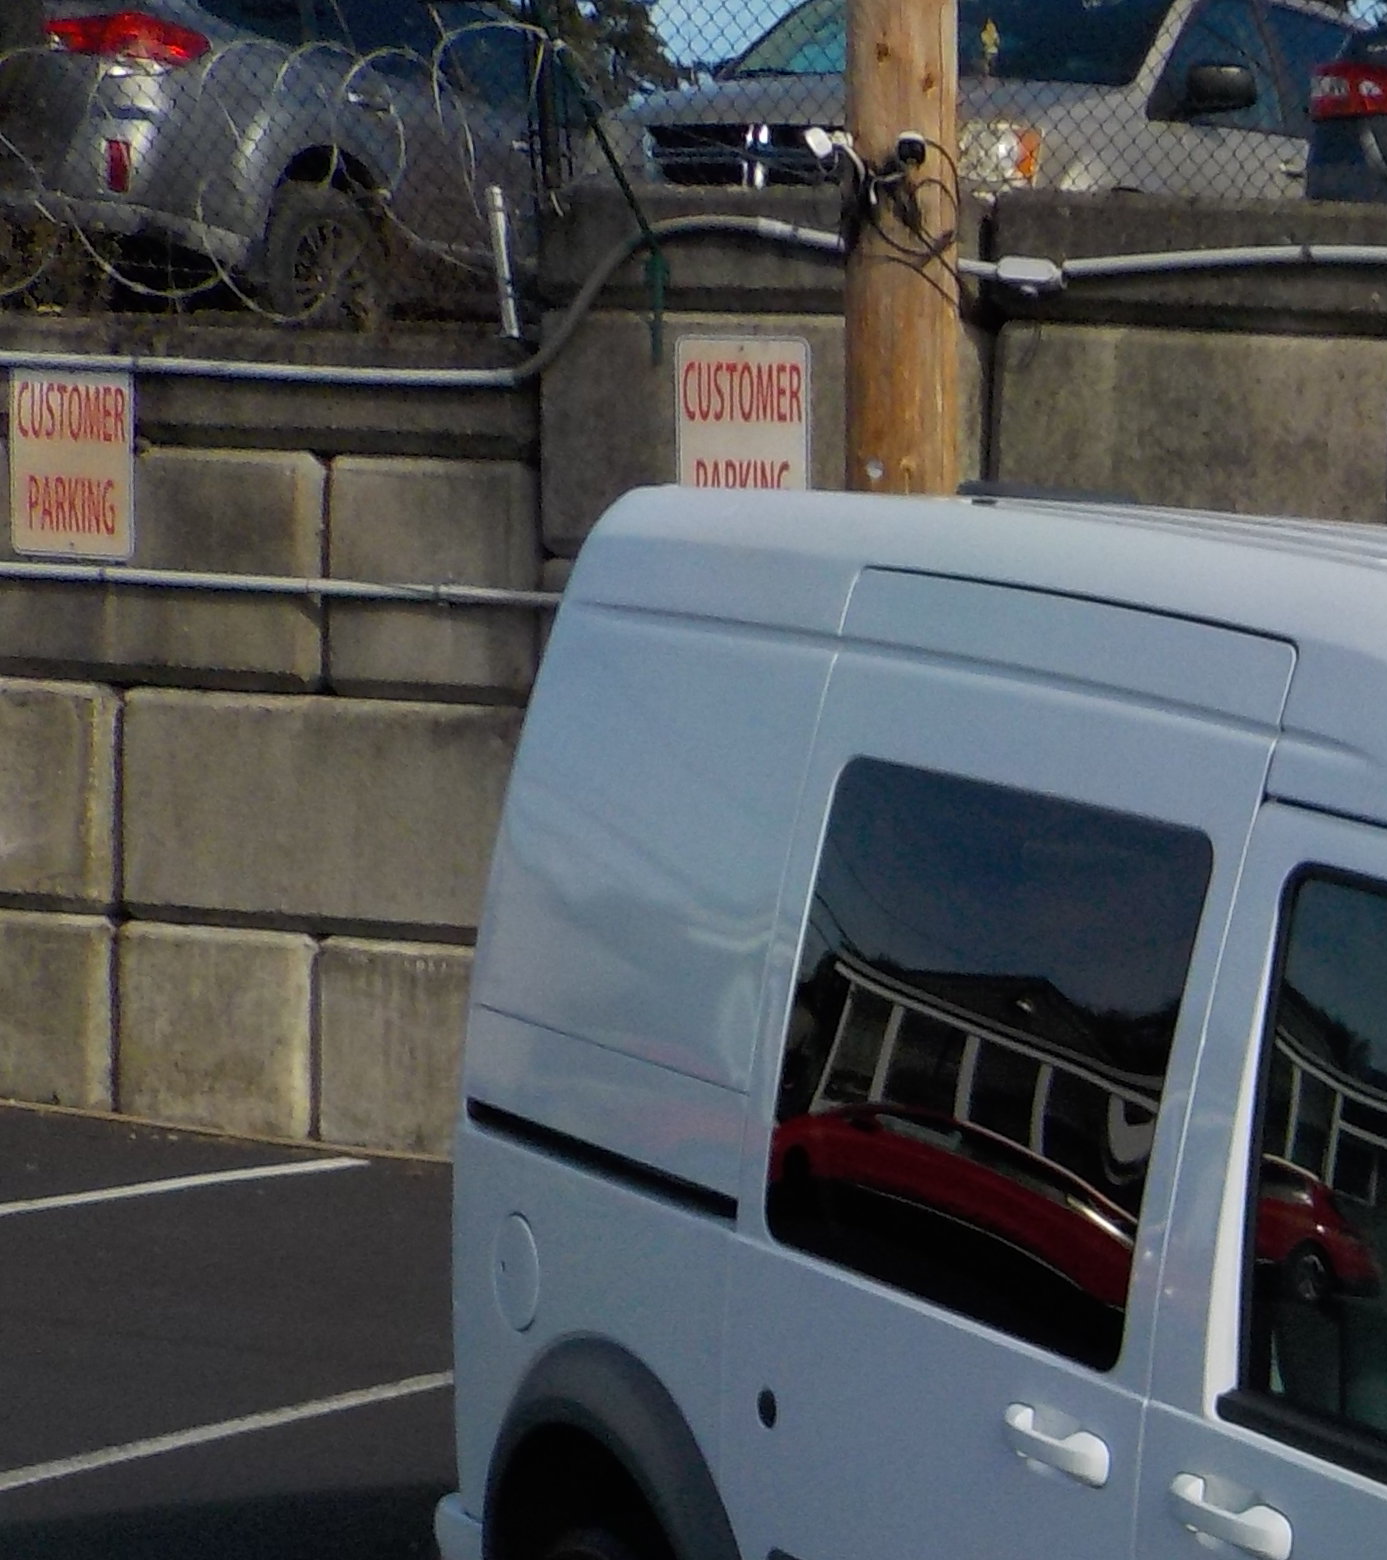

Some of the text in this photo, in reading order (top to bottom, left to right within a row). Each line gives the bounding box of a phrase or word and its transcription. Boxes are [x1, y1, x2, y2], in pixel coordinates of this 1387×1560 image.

[17, 382, 125, 442] CUSTOMER
[683, 361, 801, 422] CUSTOMER
[27, 475, 117, 535] PARKING
